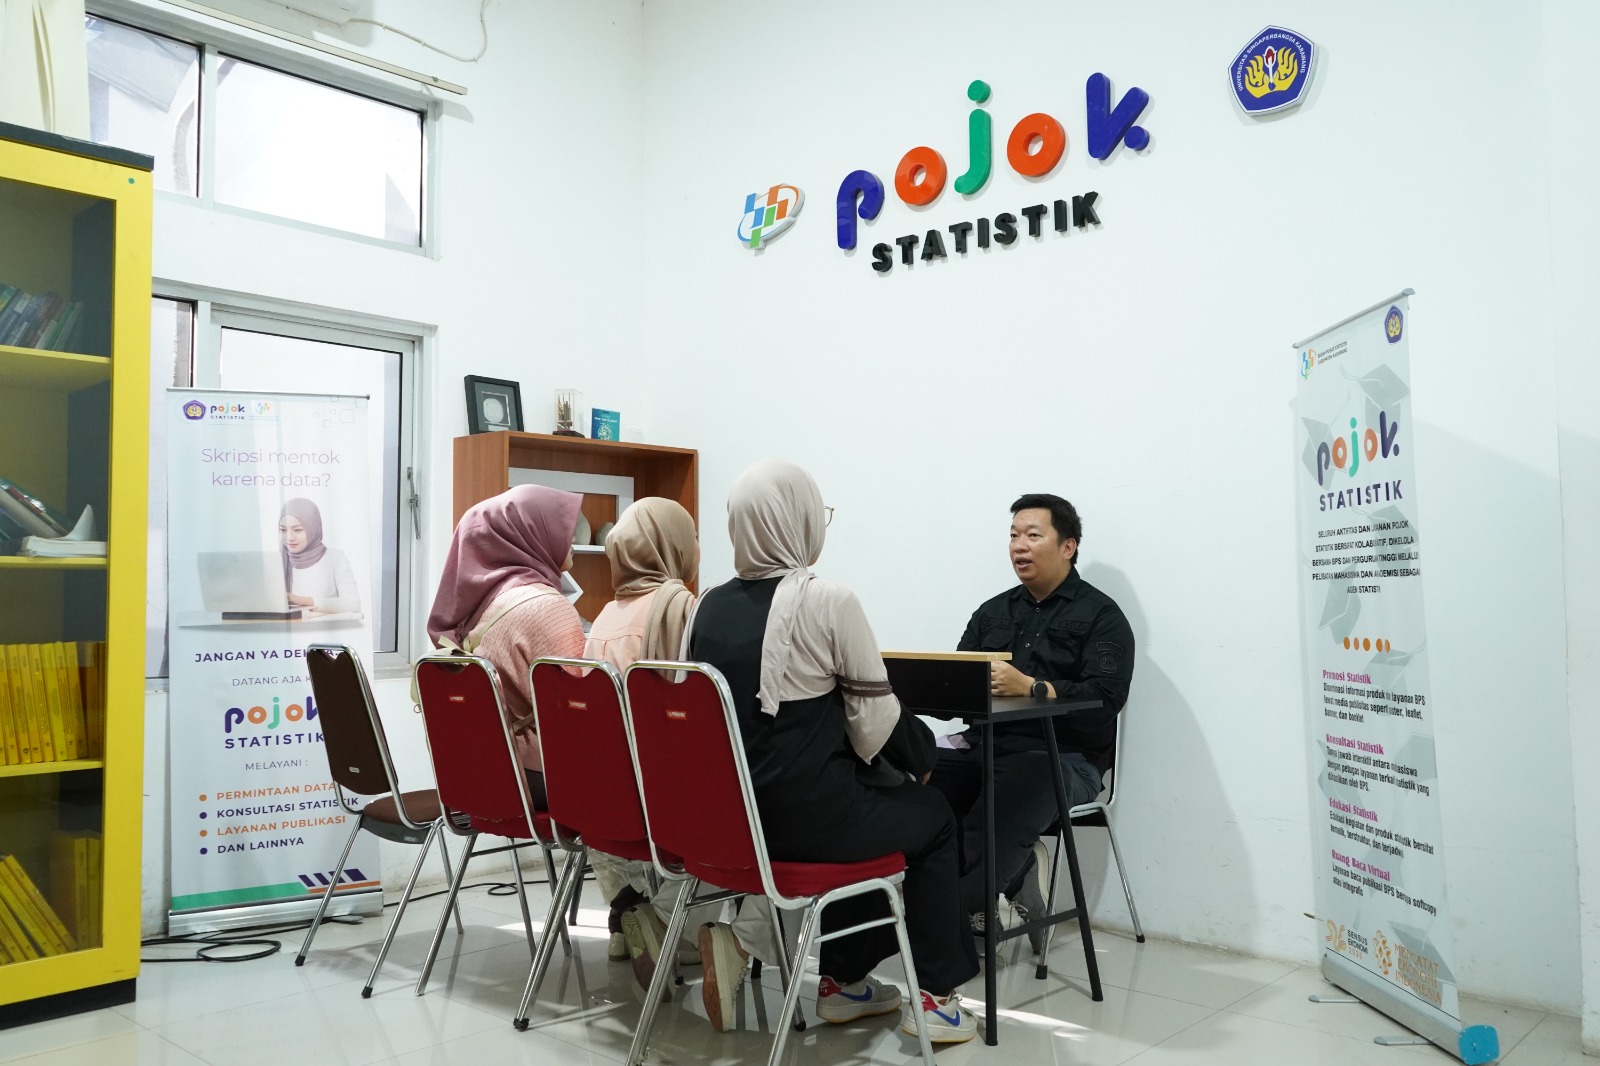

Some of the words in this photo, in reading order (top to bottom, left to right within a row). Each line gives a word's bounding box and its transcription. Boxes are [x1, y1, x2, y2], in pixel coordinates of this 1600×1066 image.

[1236, 54, 1248, 92] UNIVERSITAS
[1247, 33, 1296, 54] SINGAPERBANGSA
[1295, 41, 1307, 73] KARAWANG
[836, 72, 1150, 250] pojok
[871, 190, 1102, 273] STATISTIK
[210, 403, 245, 414] pojok
[1317, 410, 1400, 486] pojok
[201, 449, 263, 466] Skripsi
[268, 450, 340, 465] mentok
[212, 472, 276, 486] karena
[281, 472, 331, 487] data?
[1320, 480, 1403, 512] STATISTIK
[1392, 520, 1409, 529] POJOK
[1316, 544, 1334, 552] STATISTIK
[1389, 536, 1414, 545] DIKELOLA
[1332, 557, 1341, 565] BPS
[1361, 570, 1373, 578] DAN
[195, 651, 255, 663] JANGAN
[261, 650, 278, 659] YA
[232, 676, 278, 687] DATANG
[282, 676, 302, 684] AJA
[1323, 670, 1345, 681] Promosi
[1347, 672, 1371, 684] Statistik
[1335, 698, 1348, 707] media
[1346, 685, 1365, 697] informasi
[1367, 690, 1385, 699] produk
[1392, 692, 1413, 704] layanan
[1415, 695, 1425, 706] BPS
[1339, 710, 1347, 720] dan
[224, 732, 325, 749] STATISTIK
[1326, 734, 1355, 749] Konsultasi
[1357, 741, 1384, 755] Statistik
[245, 759, 302, 771] MELAYANI
[1338, 749, 1351, 760] jawab
[1373, 759, 1390, 770] antara
[1342, 764, 1359, 776] petugas
[1360, 768, 1378, 780] layanan
[1417, 784, 1429, 796] yang
[1349, 778, 1358, 788] oleh
[216, 785, 300, 801] PERMINTAAN
[304, 783, 335, 793] DATA
[217, 803, 295, 818] KONSULTASI
[1330, 798, 1351, 813] Edukasi
[1353, 806, 1378, 822] Statistik
[217, 822, 277, 836] LAYANAN
[281, 815, 346, 830] PUBLIKASI
[1346, 816, 1364, 830] kegiatan
[1366, 823, 1374, 833] dan
[1375, 827, 1393, 840] produk
[1413, 839, 1434, 855] bersifat
[217, 843, 245, 854] DAN
[250, 837, 304, 850] LAINNYA
[1372, 839, 1381, 850] dan
[1332, 850, 1350, 867] Ruang
[1352, 858, 1366, 872] Baca
[1368, 864, 1390, 881] Virtual
[1332, 862, 1349, 878] Layanan
[1350, 870, 1361, 882] baca
[1384, 884, 1394, 896] BPS
[1413, 898, 1436, 916] softcopy
[1347, 930, 1368, 946] SENSUS
[1348, 938, 1368, 954] EKONOMI
[1394, 943, 1438, 974] MENCATAT
[1398, 958, 1437, 988] EKONOMI
[1395, 970, 1441, 1003] INDONESIA
